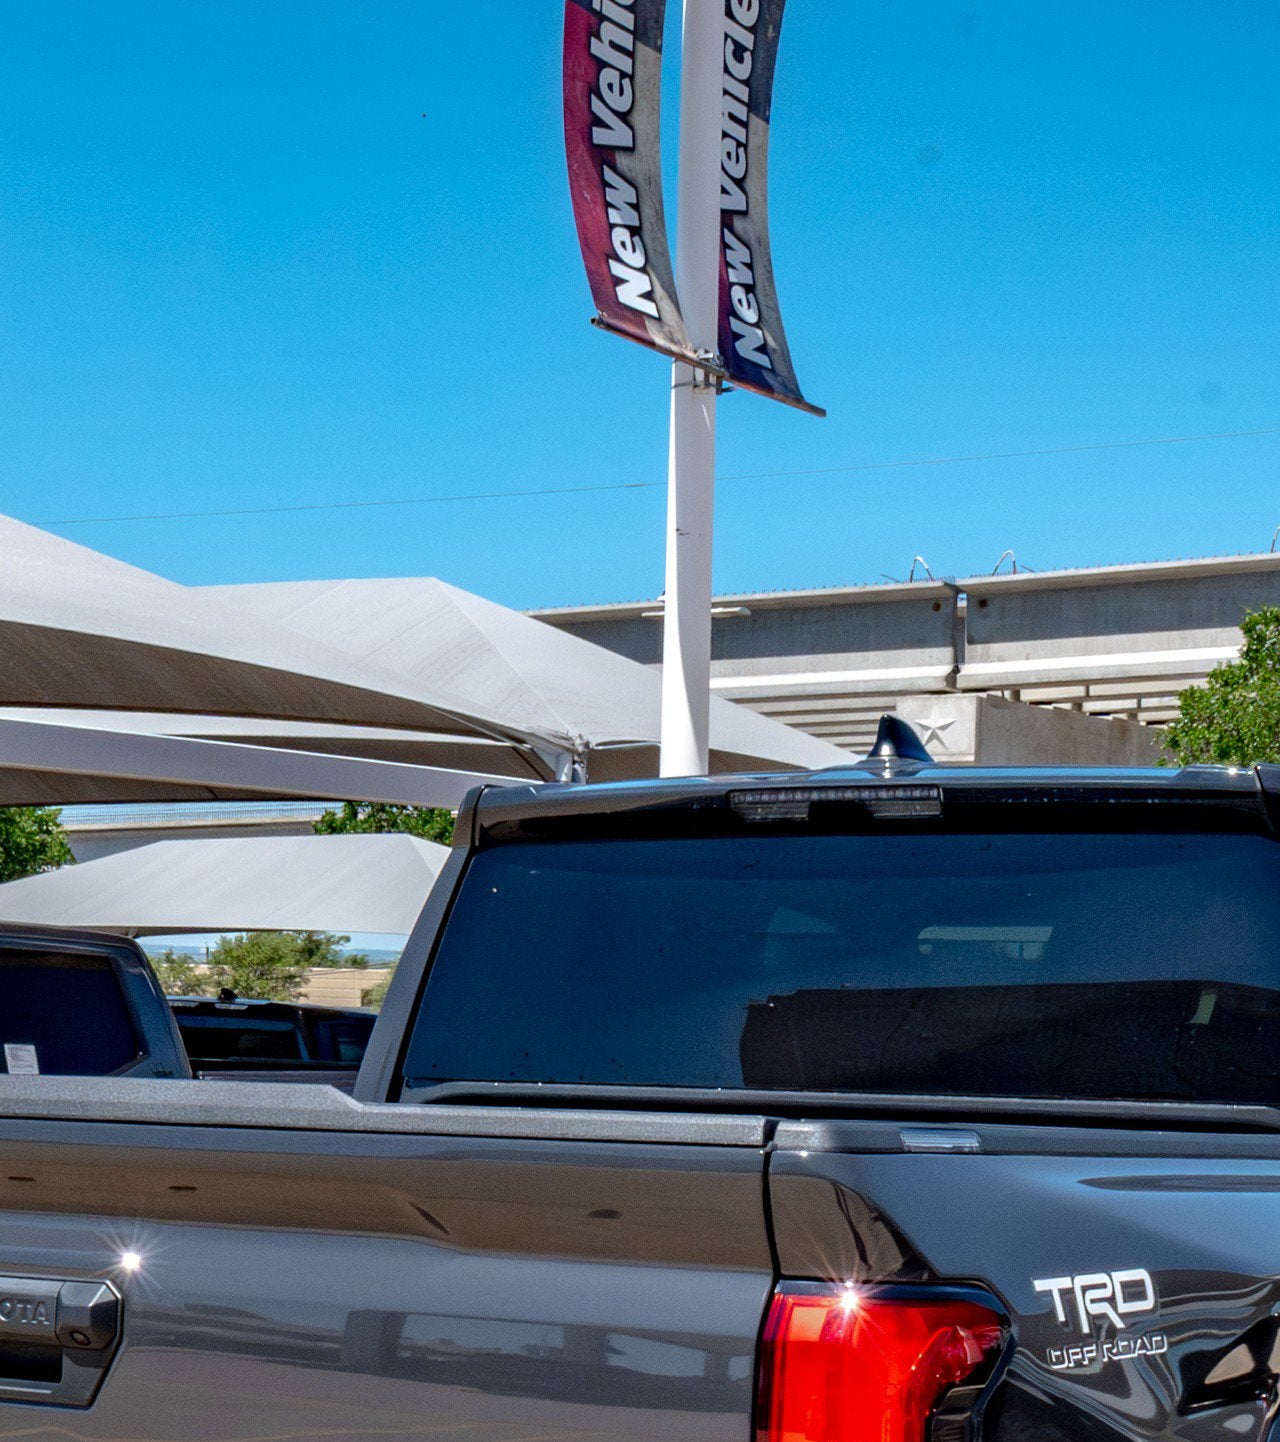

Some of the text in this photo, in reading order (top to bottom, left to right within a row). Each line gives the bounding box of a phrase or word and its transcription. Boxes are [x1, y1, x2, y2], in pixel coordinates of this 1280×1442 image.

[590, 0, 659, 319] New Vehi
[723, 227, 771, 369] New
[1032, 1267, 1156, 1335] TRD
[1047, 1334, 1168, 1369] OFF ROAD
